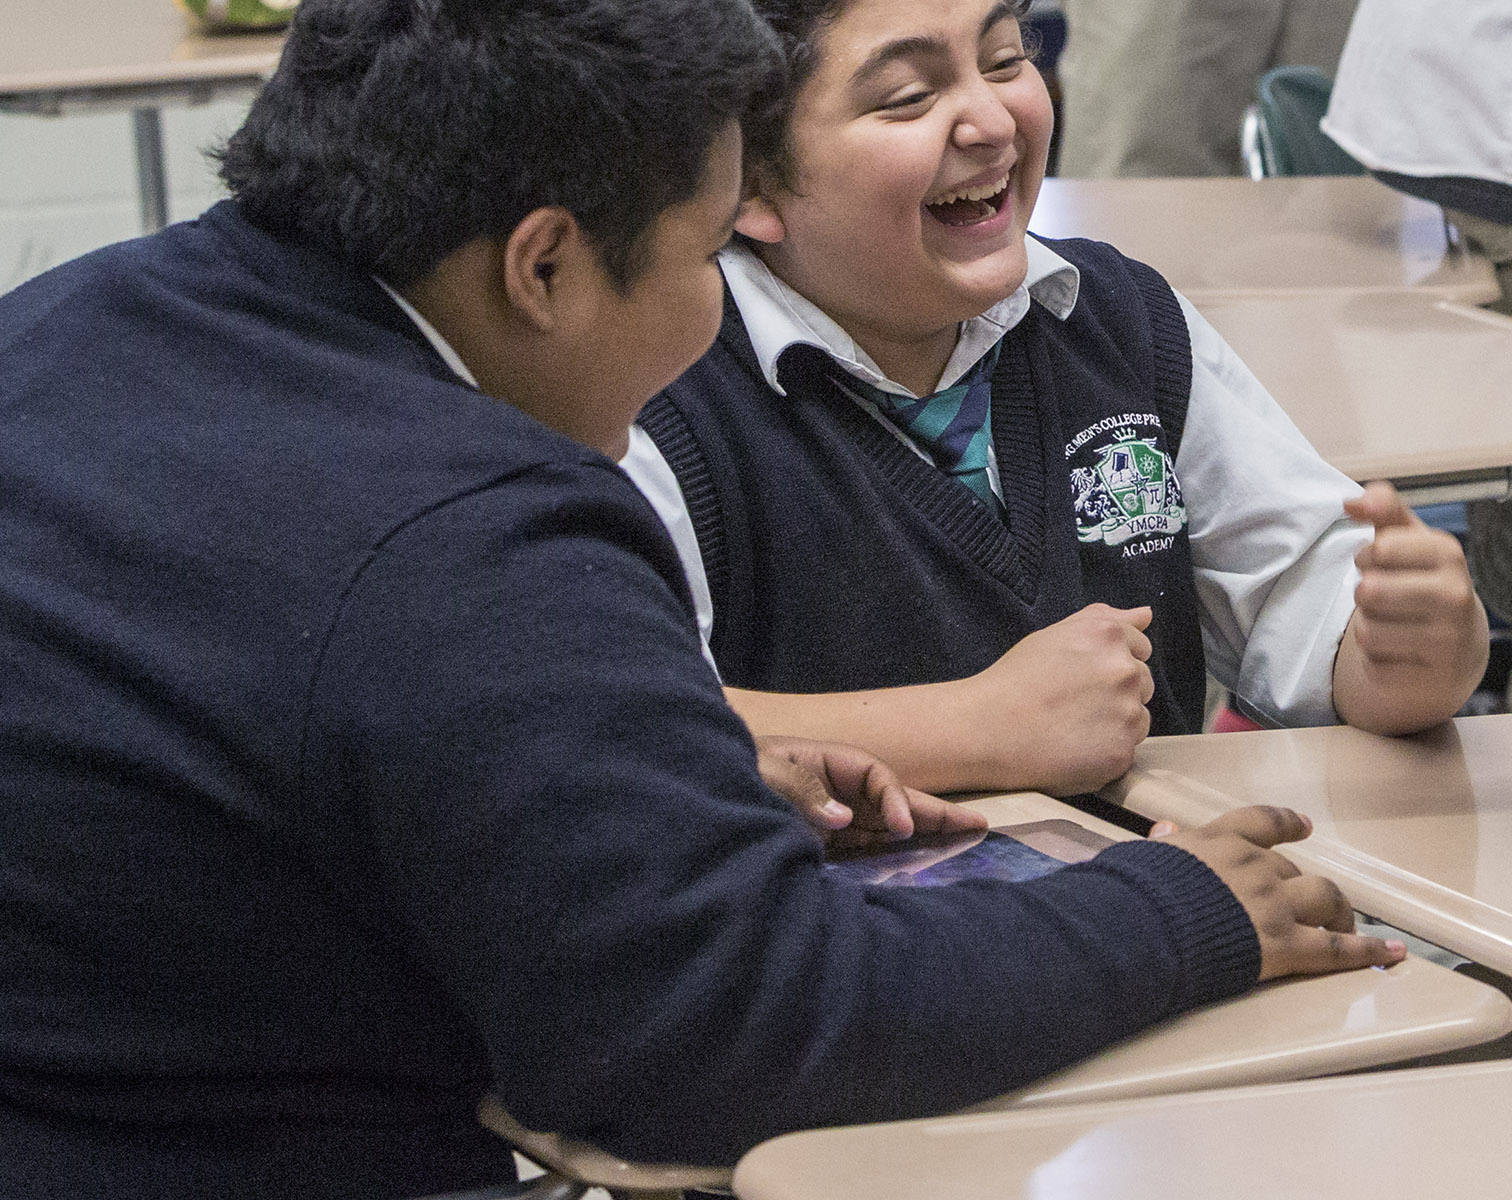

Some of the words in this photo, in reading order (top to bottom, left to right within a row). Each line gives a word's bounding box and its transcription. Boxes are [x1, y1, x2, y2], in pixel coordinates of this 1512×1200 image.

[1071, 423, 1103, 448] MEN'S
[1099, 412, 1144, 431] COLLEGE
[1126, 515, 1168, 534] YMCPA
[1122, 536, 1175, 558] ACADEMY
